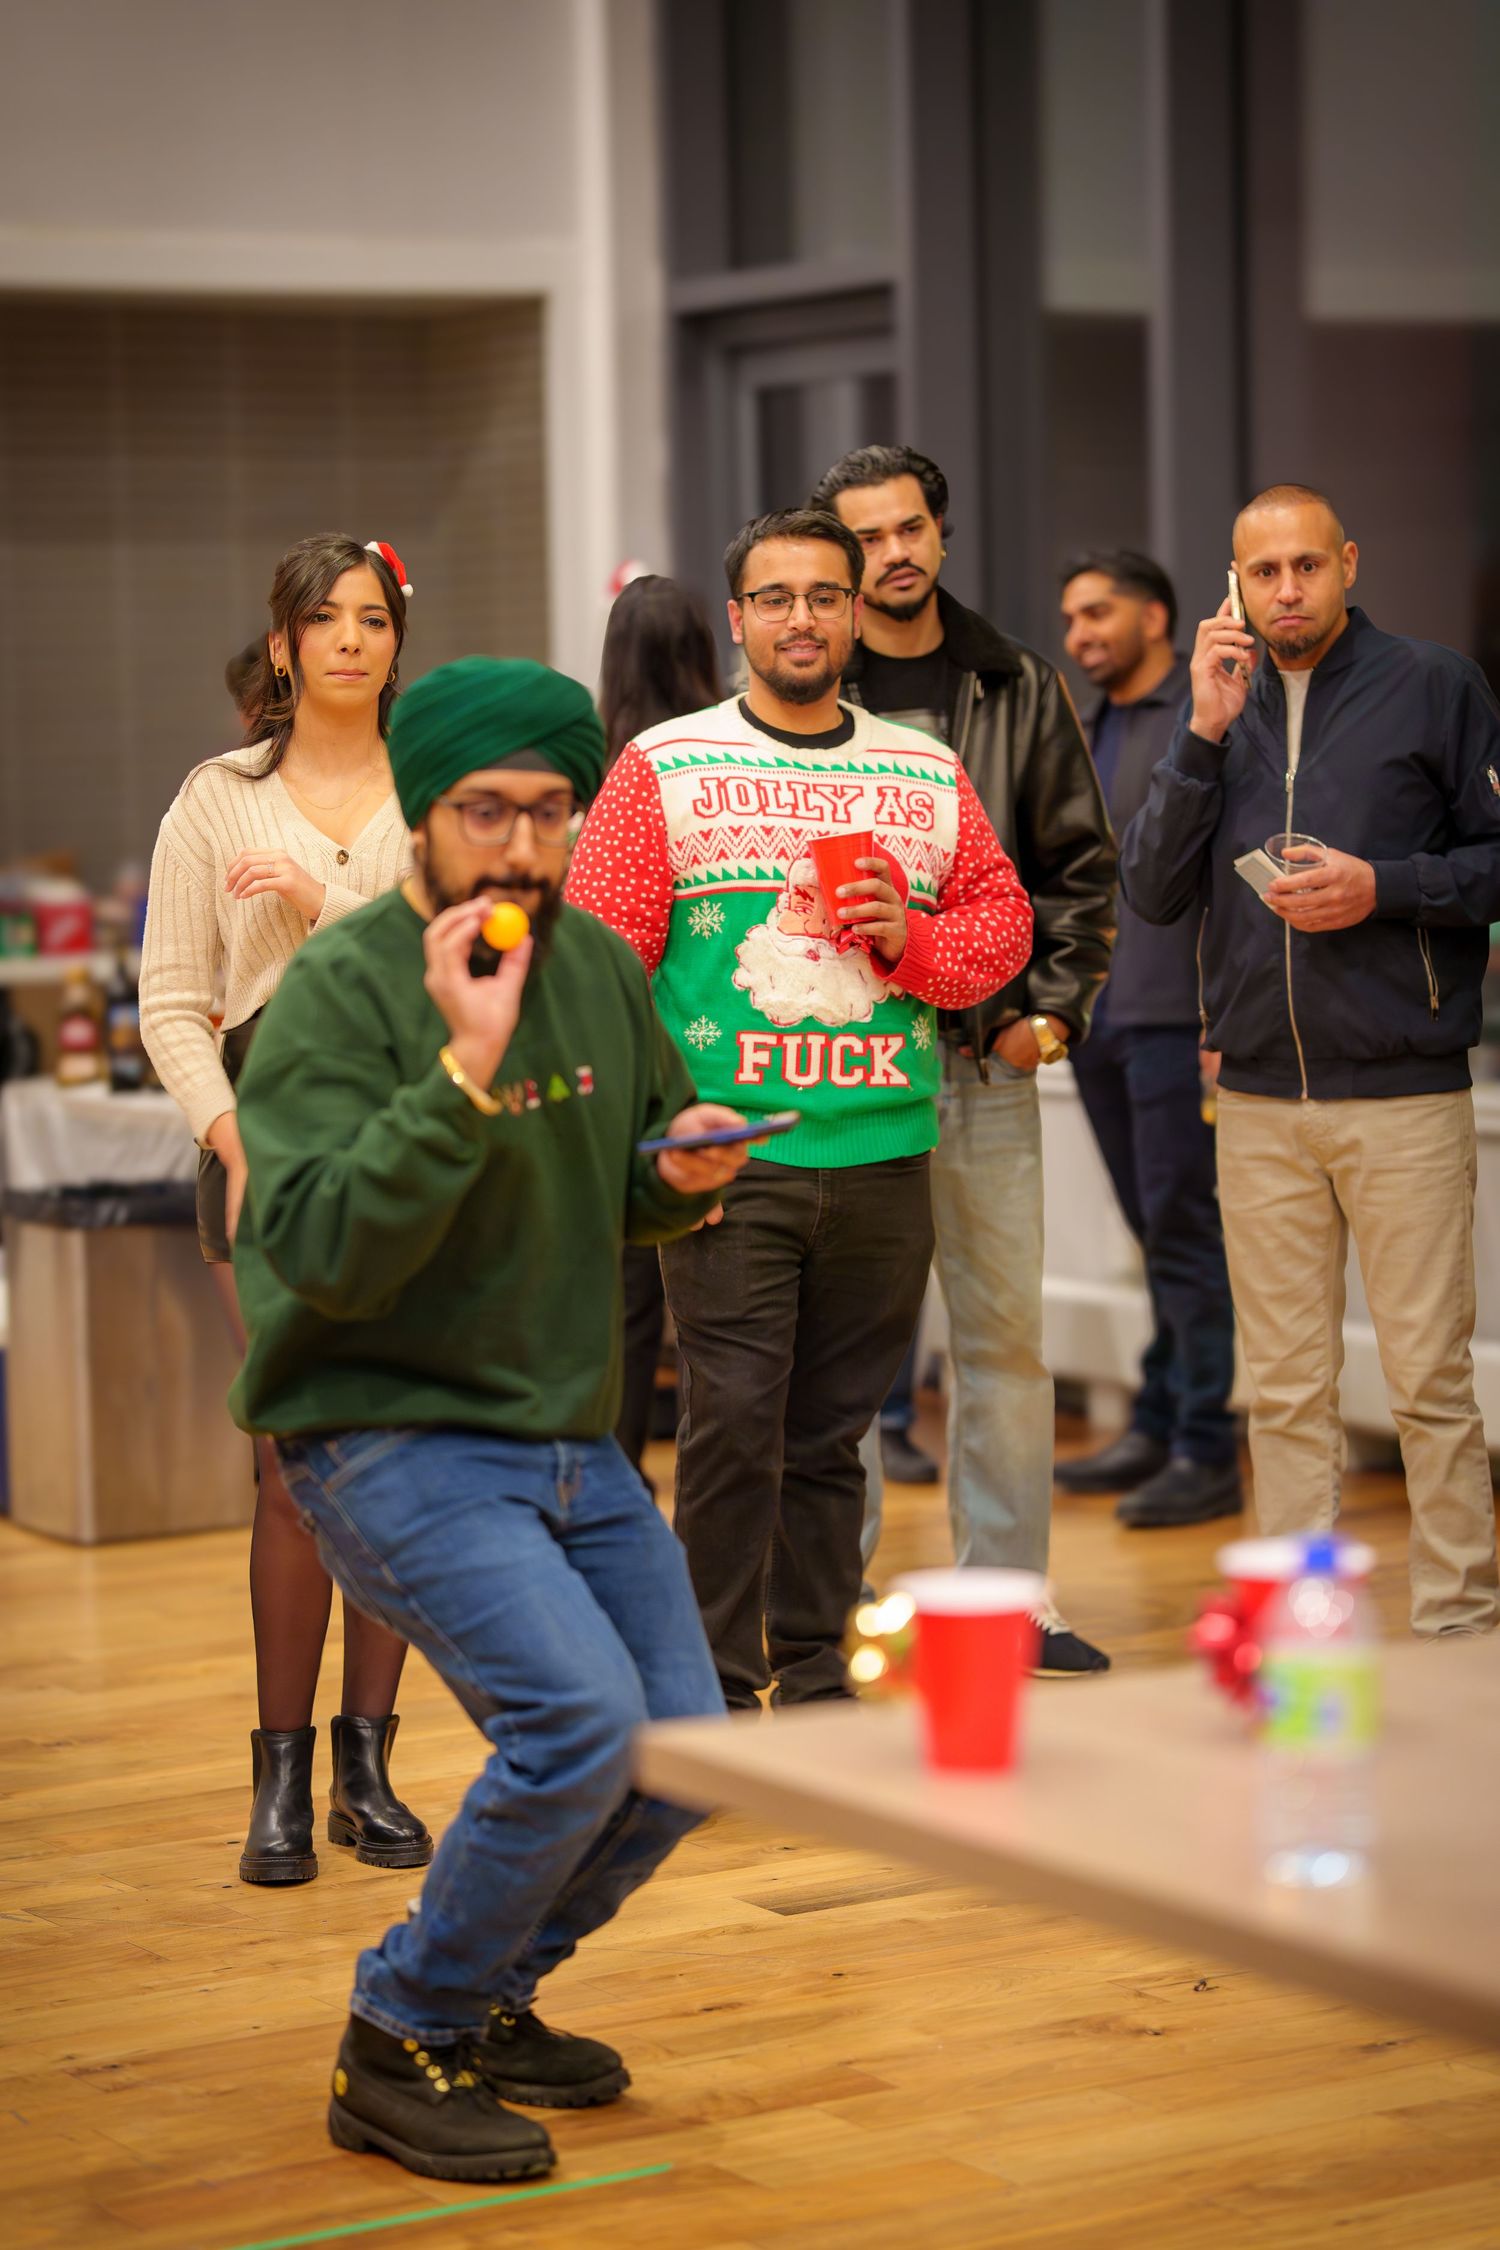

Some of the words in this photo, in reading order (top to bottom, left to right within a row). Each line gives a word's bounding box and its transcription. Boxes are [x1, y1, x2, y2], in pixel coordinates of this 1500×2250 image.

[692, 777, 863, 823] JOLLY
[874, 787, 935, 831] AS
[735, 1030, 911, 1088] FUCK
